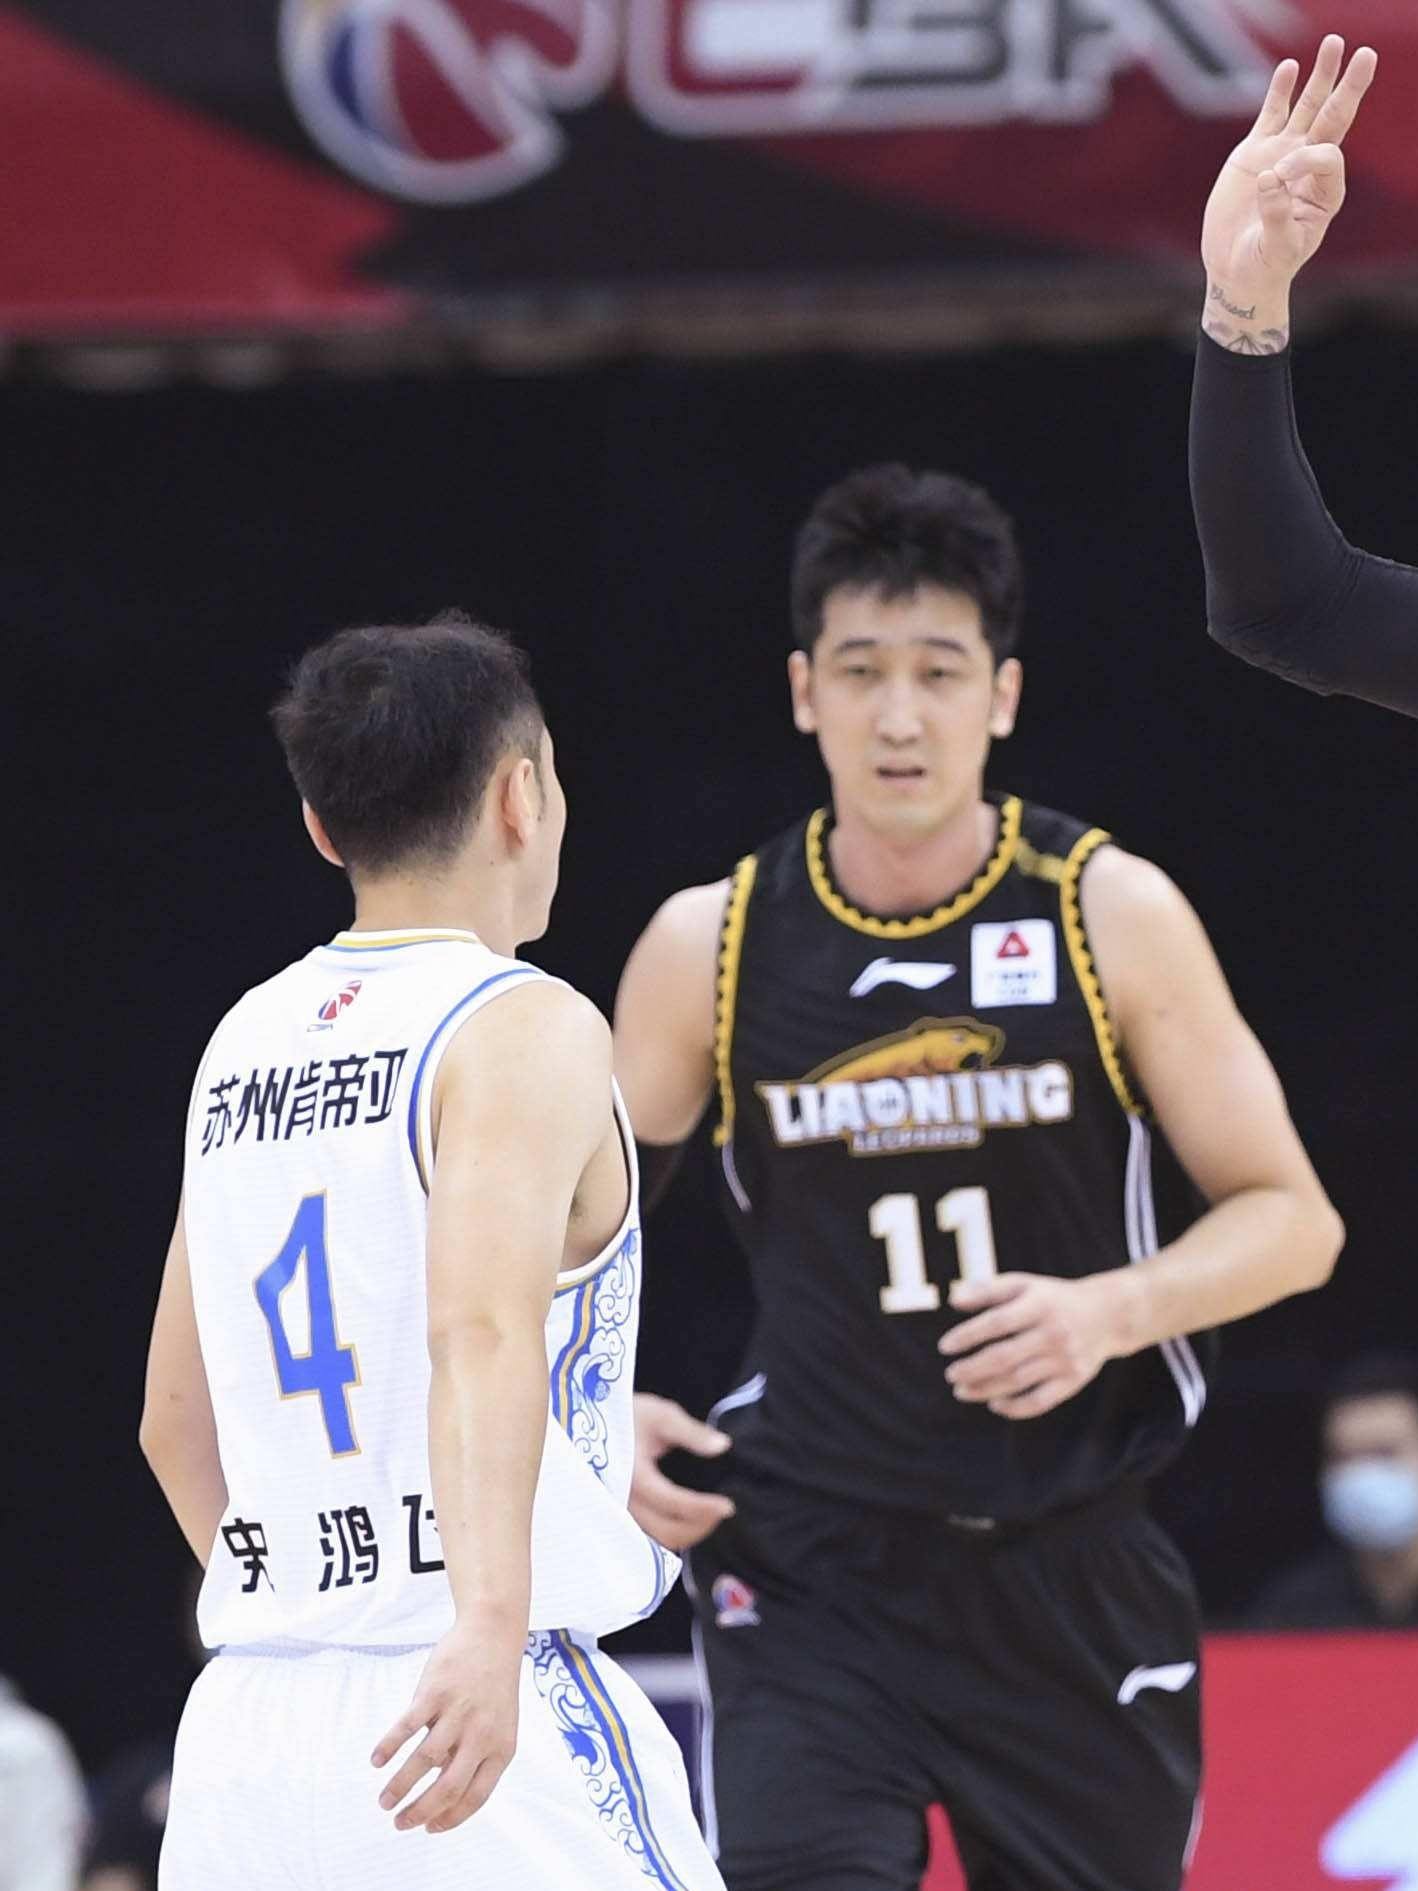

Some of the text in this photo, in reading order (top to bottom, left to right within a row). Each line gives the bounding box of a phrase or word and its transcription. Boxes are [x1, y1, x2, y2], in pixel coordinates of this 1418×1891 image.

[762, 1064, 1071, 1141] LIAONING
[869, 1186, 997, 1314] 11
[253, 1188, 361, 1459] 4
